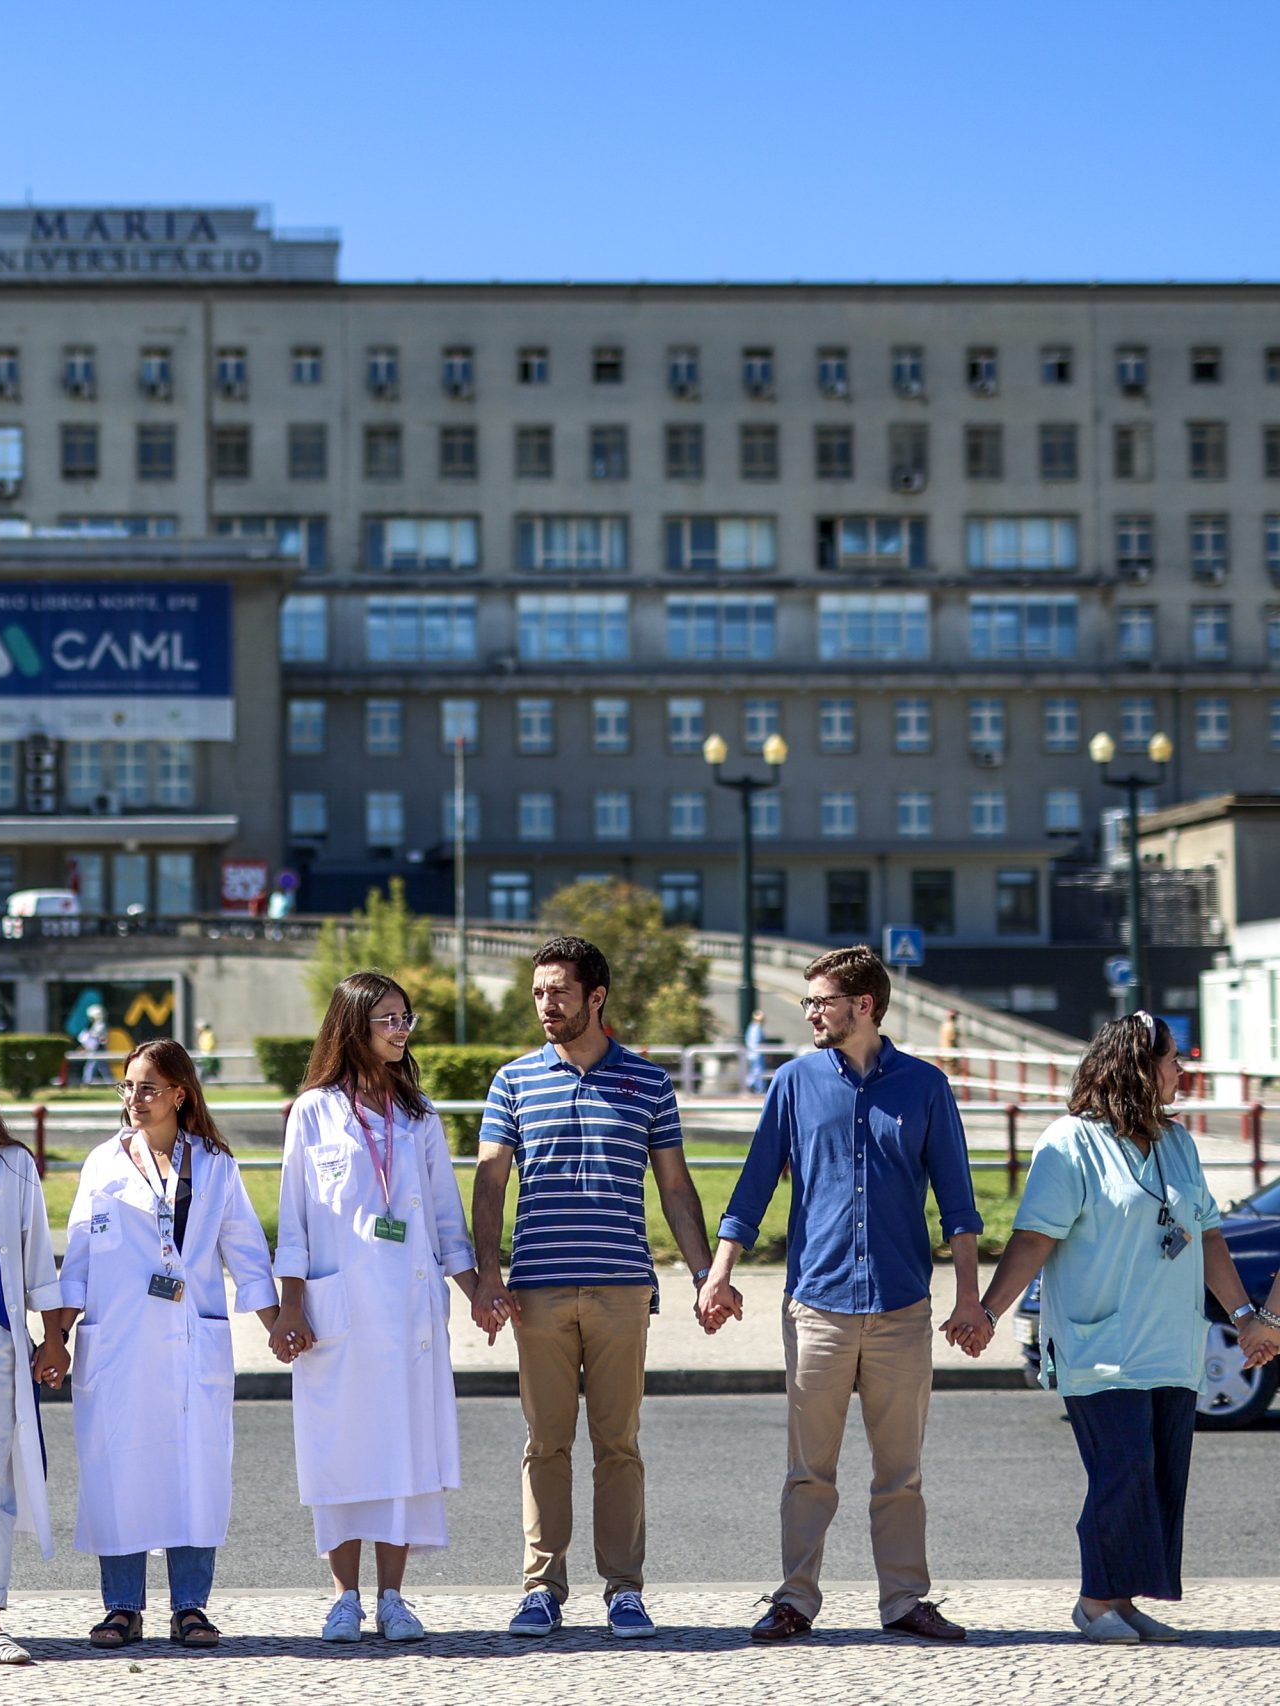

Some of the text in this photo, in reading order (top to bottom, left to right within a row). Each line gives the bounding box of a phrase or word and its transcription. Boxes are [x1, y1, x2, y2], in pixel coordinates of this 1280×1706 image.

[31, 212, 218, 242] MARIA
[31, 594, 97, 612] LISBOA
[51, 629, 200, 671] CAML
